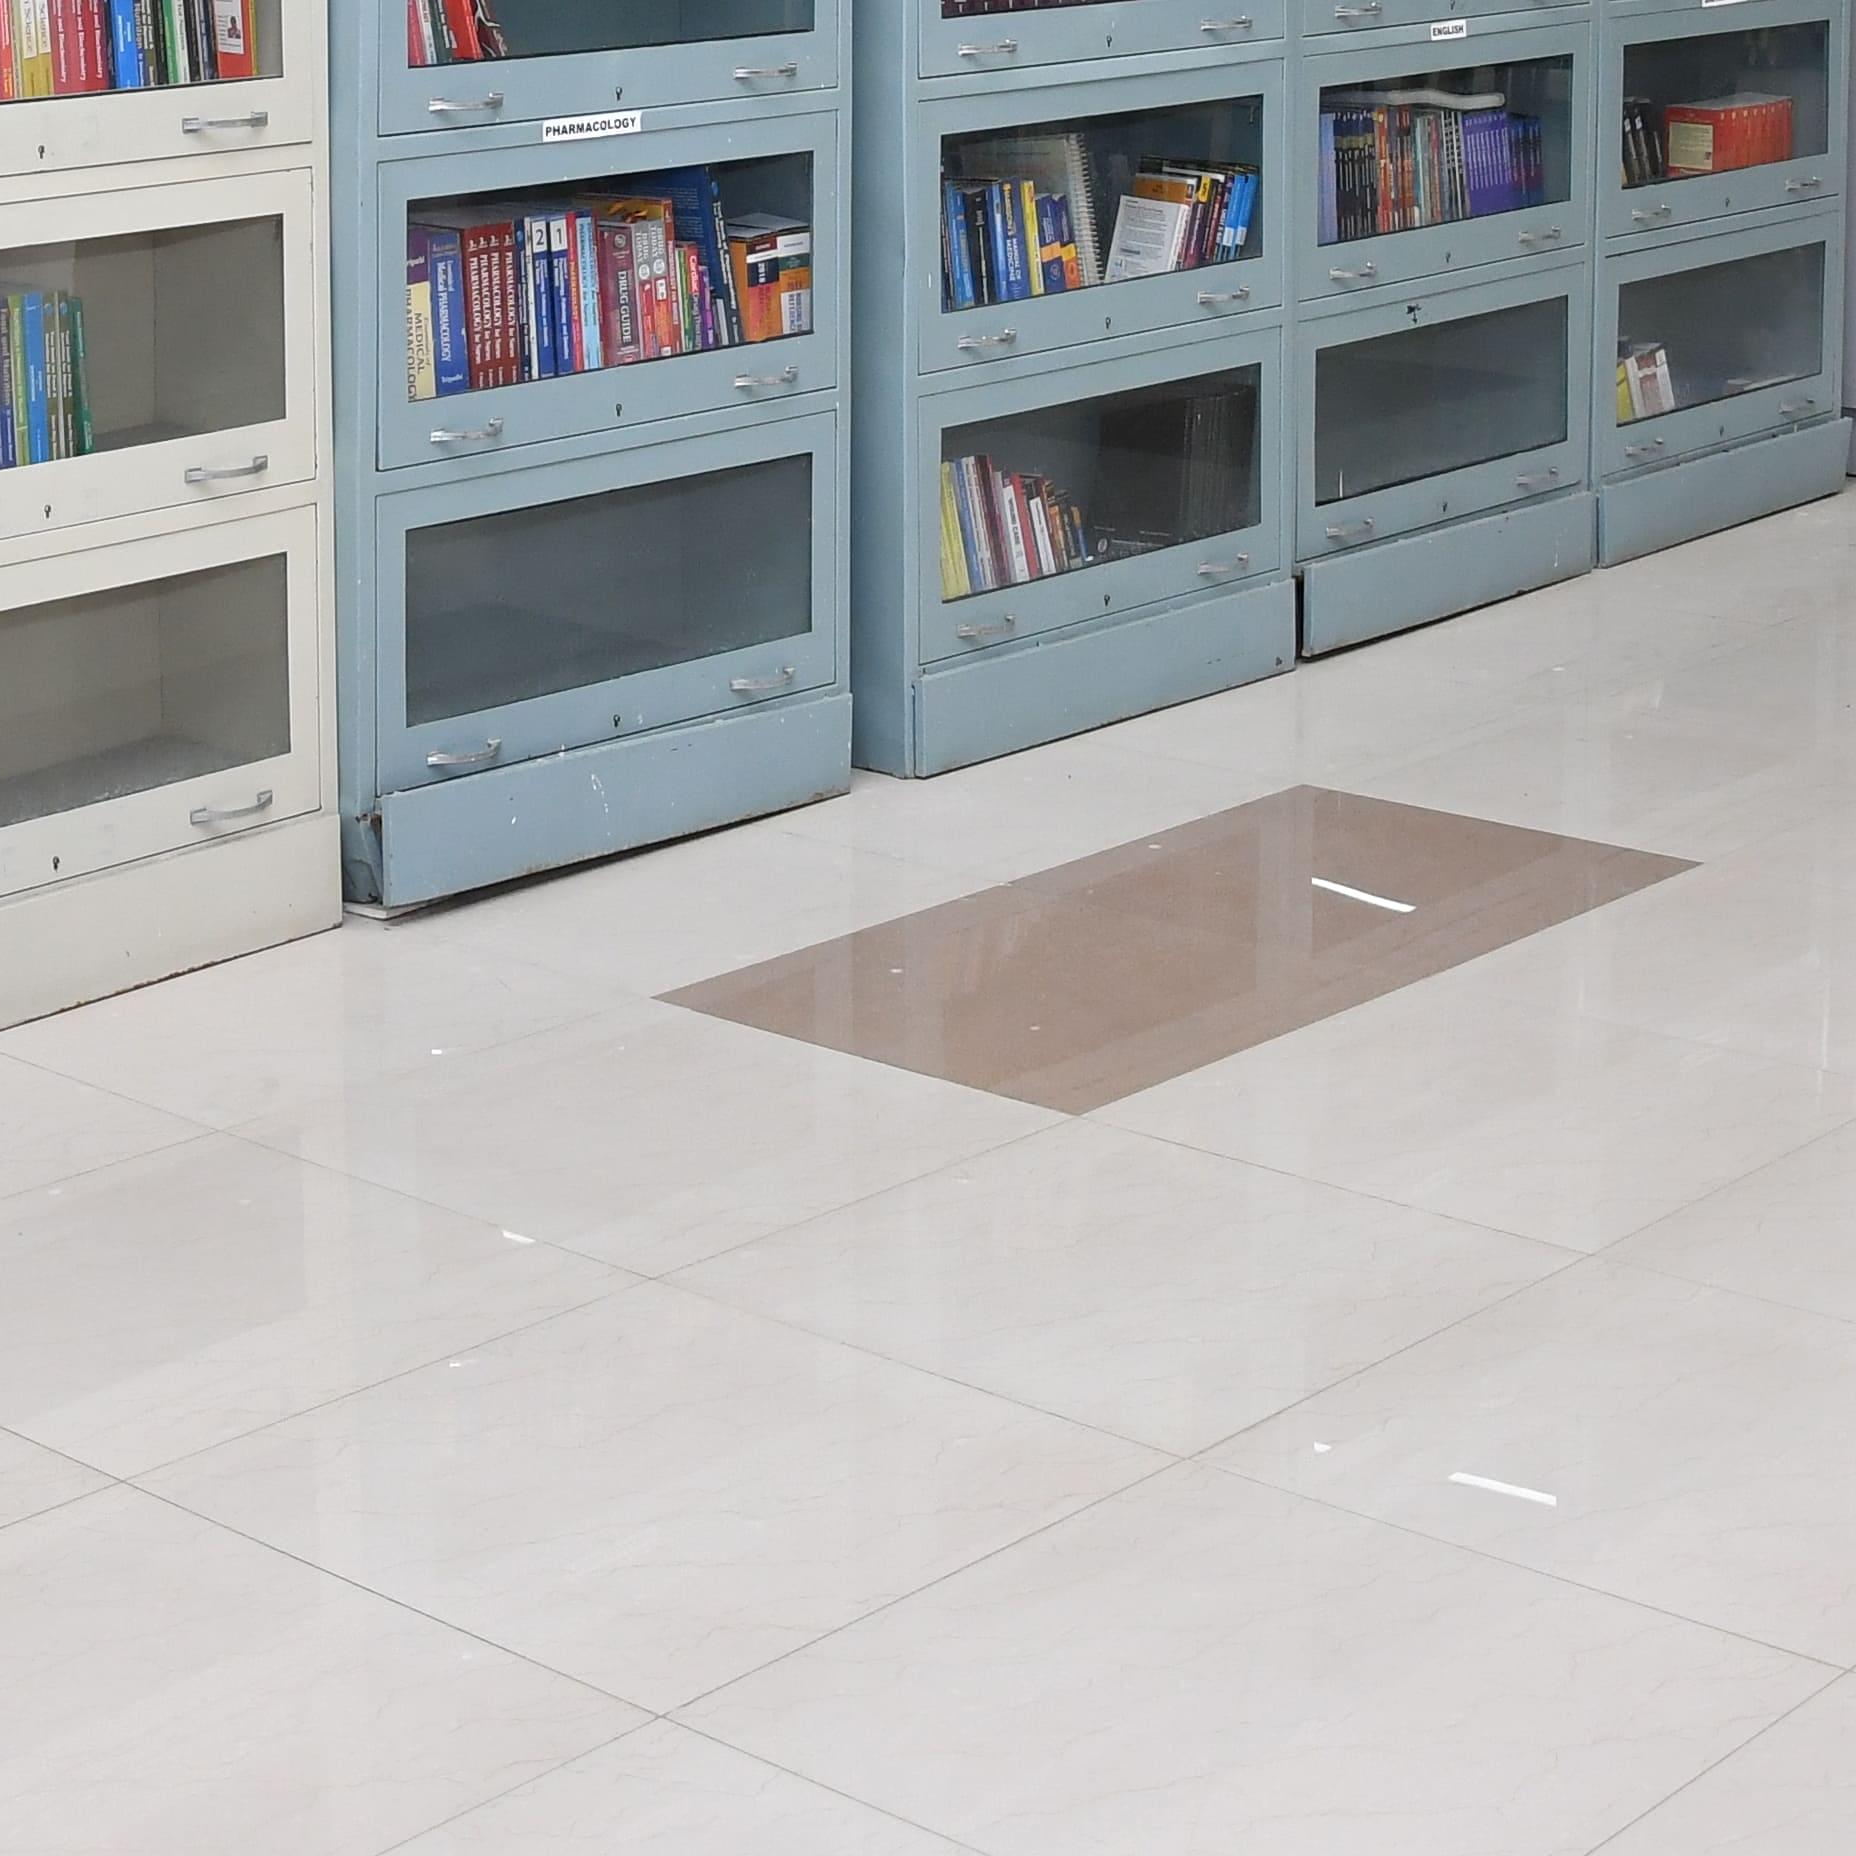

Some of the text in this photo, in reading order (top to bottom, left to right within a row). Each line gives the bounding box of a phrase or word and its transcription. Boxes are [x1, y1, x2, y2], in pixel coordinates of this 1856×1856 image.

[134, 3, 142, 48] Nutrition
[1433, 25, 1464, 36] ENGLISH
[76, 32, 86, 80] Biochemistry
[546, 117, 636, 136] PHARMACOLOGY
[536, 229, 544, 245] 2
[556, 228, 563, 244] 1
[634, 232, 642, 263] TODAY
[640, 233, 649, 258] DRUG
[648, 226, 657, 259] TODAY
[655, 227, 665, 253] DRUG
[689, 256, 698, 292] Cardiac
[1006, 238, 1014, 281] MEDICINE
[468, 257, 482, 331] PHARMACOLOGY
[479, 255, 491, 328] PHARMACOLOGY
[490, 253, 501, 326] PHARMACOLOGY
[504, 252, 516, 325] PHARMACOLOGY
[617, 271, 631, 343] DRUG GUIDE
[412, 313, 426, 374] MEDICAL
[437, 293, 450, 361] PHARMACOLOGY
